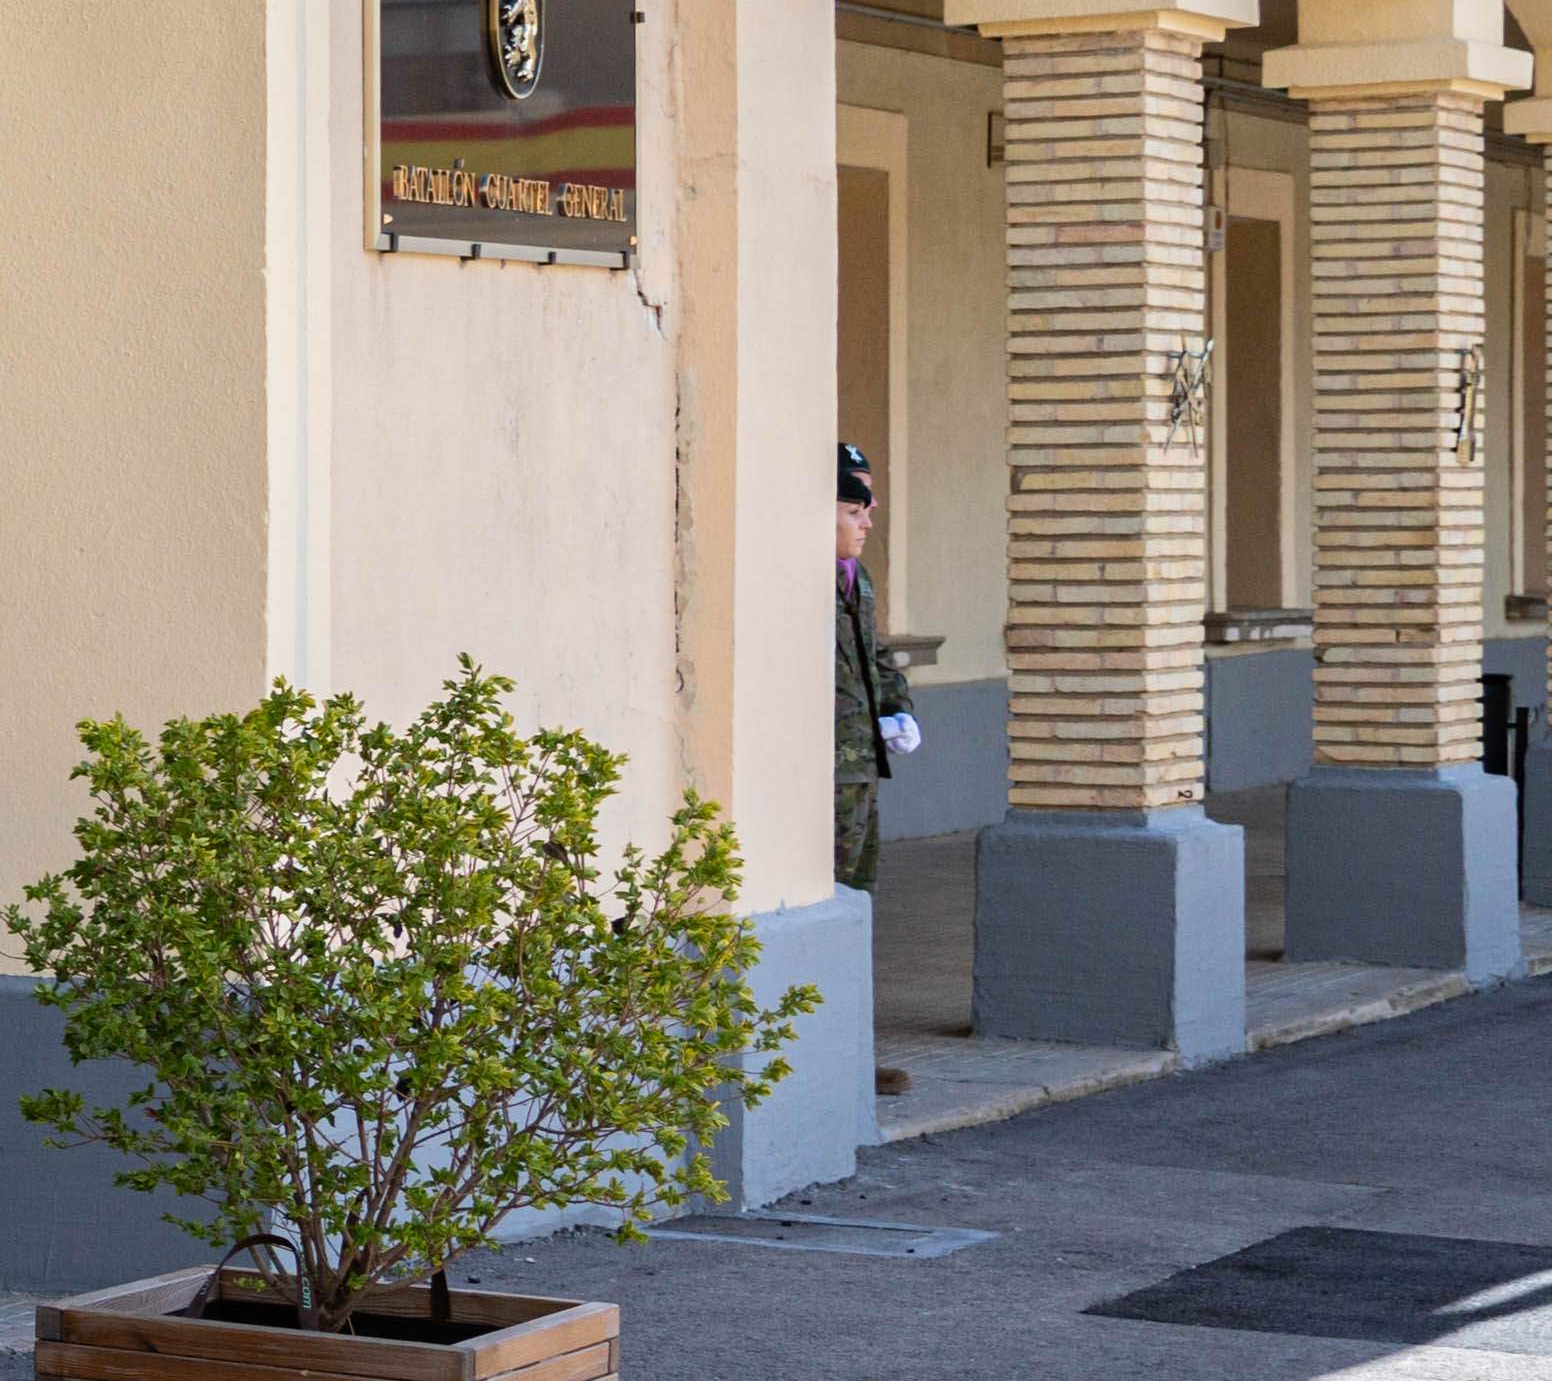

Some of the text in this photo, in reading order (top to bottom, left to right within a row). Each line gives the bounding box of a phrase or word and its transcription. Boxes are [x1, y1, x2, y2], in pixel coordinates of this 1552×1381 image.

[394, 158, 626, 222] BATALLÓN CUARTEL GENERAL
